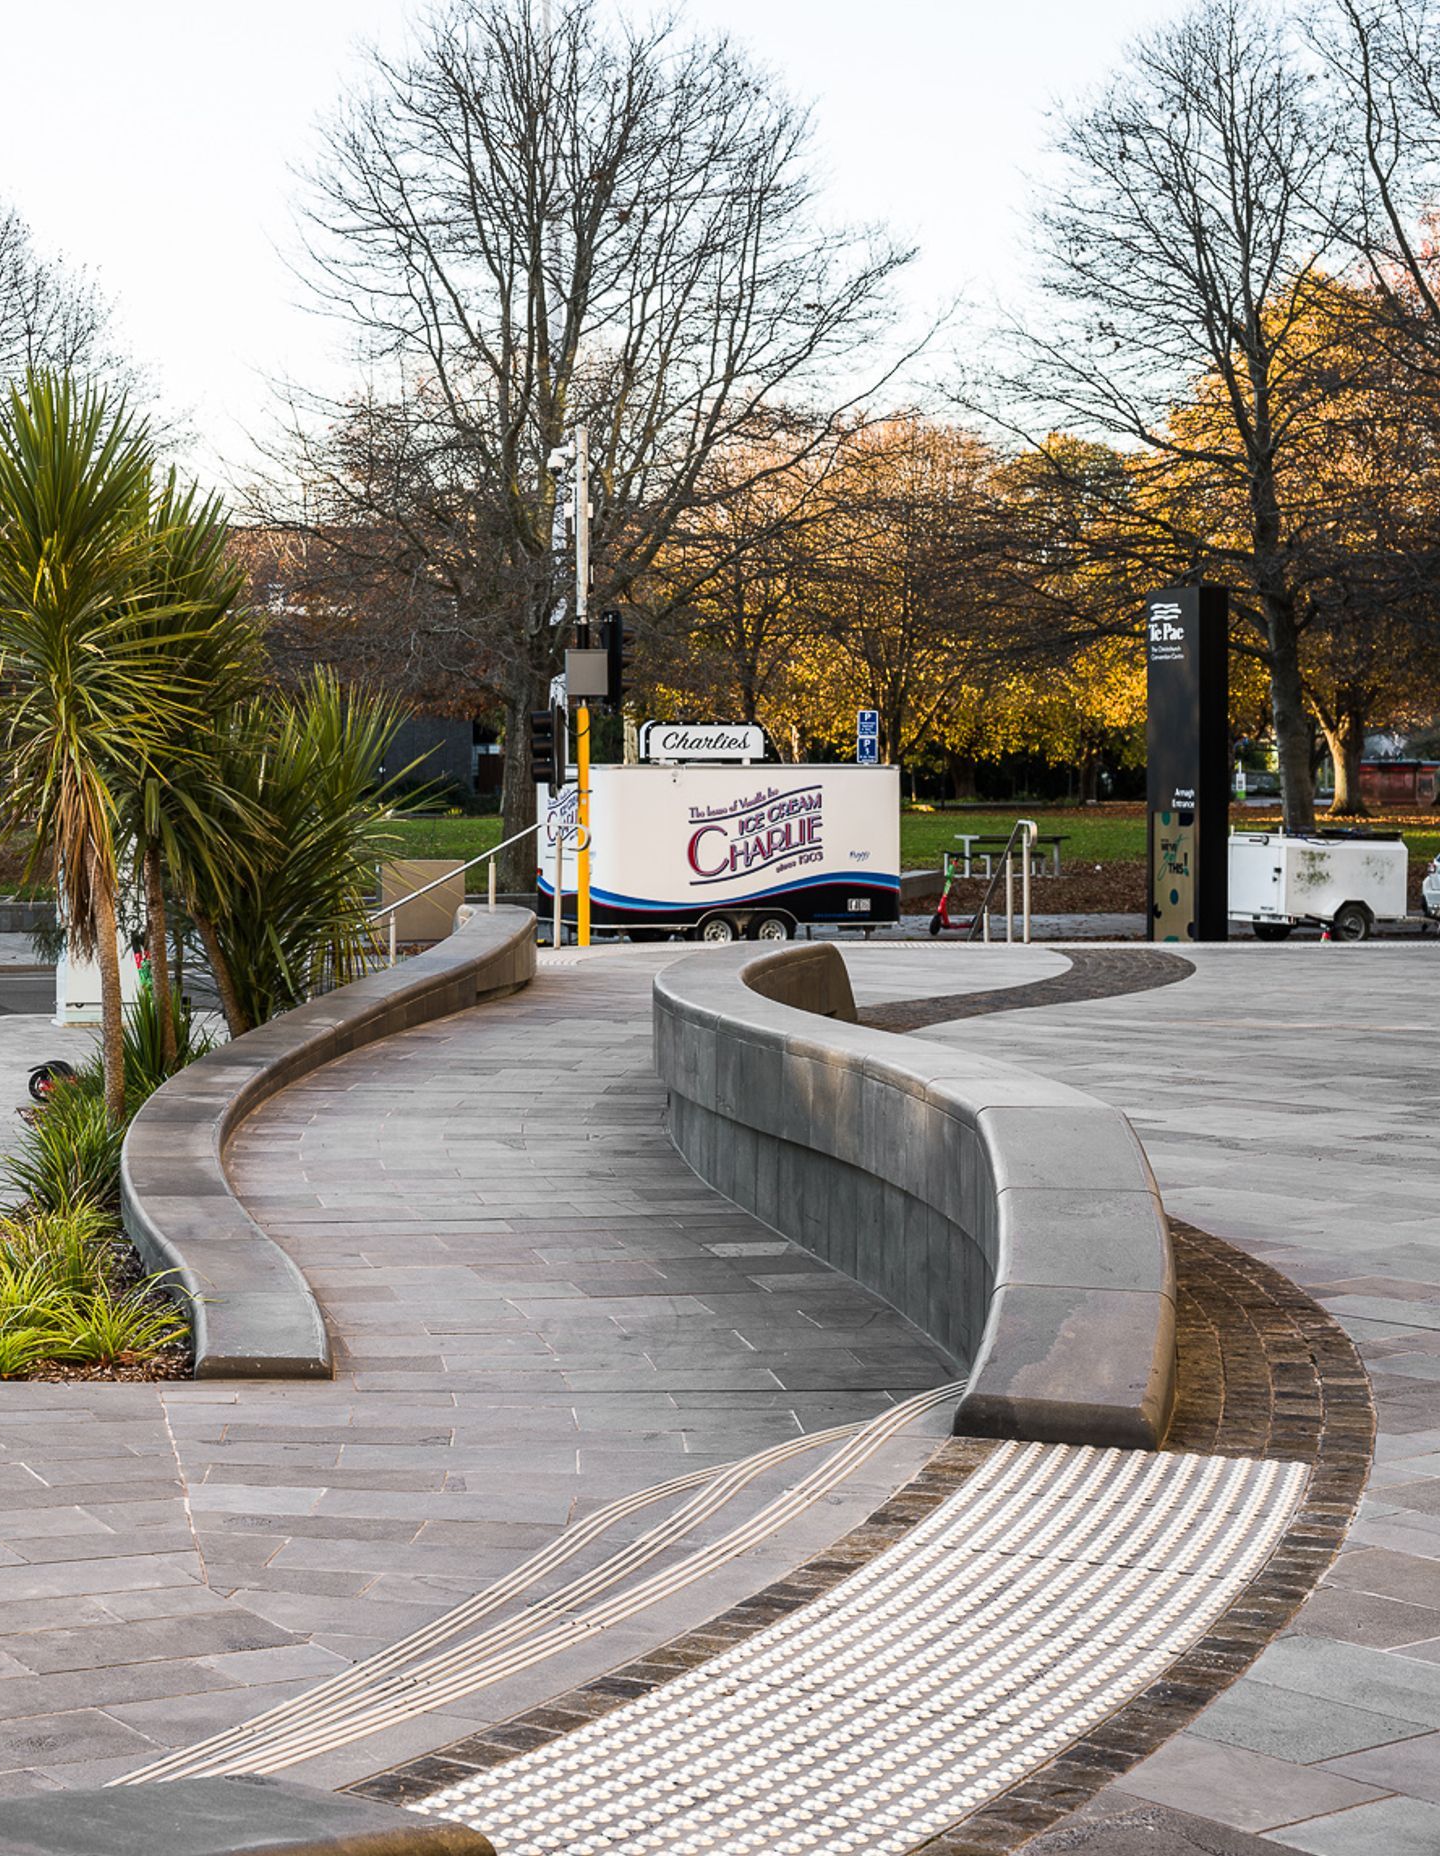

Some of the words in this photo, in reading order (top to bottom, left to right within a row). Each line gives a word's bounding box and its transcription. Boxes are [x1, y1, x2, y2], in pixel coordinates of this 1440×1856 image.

[1148, 623, 1162, 641] Te
[1163, 622, 1184, 641] Pae
[864, 713, 871, 721] P
[662, 731, 750, 750] Charlies
[863, 739, 871, 747] P
[738, 812, 765, 836] ICE
[767, 792, 822, 823] CREAM
[687, 815, 823, 877] CHARLIE
[798, 851, 824, 865] 1903
